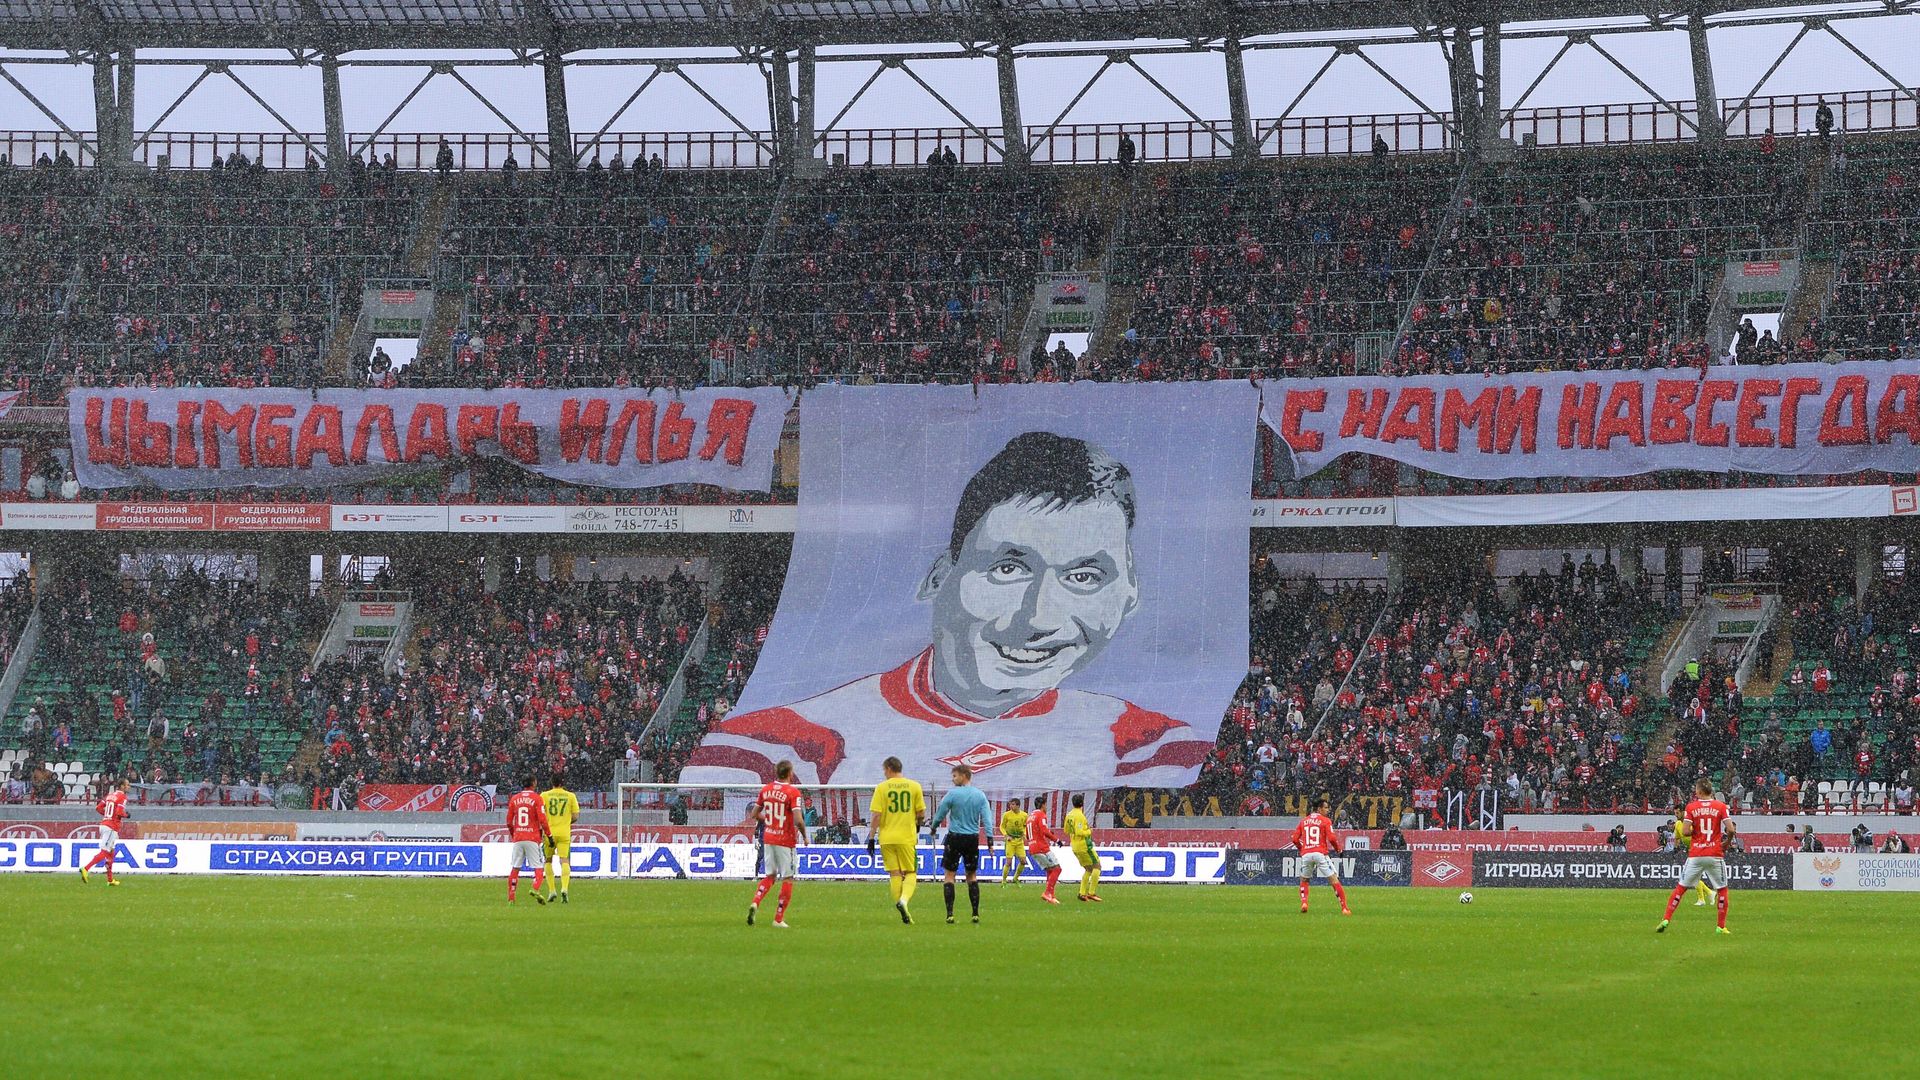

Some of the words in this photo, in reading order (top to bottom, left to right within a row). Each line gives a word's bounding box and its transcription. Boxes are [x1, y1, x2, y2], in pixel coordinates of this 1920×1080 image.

[1281, 388, 1328, 452] С
[1339, 385, 1542, 454] НАМИ
[1557, 374, 1920, 450] НАВСЕГДА
[85, 396, 540, 468] ЦЫМБАЛАРЬ
[558, 398, 756, 467] ИЛЬЯ
[122, 506, 188, 514] ФЕДЕРАЛЬНАЯ
[240, 506, 306, 514] ФЕДЕРАЛЬНАЯ
[615, 507, 678, 517] РЕСТОРАН
[105, 516, 150, 524] ГРУЗОВАЯ
[152, 516, 203, 524] КОМПАНИЯ
[224, 516, 268, 524] ГРУЗОВАЯ
[271, 516, 321, 524] КОМПАНИЯ
[614, 519, 678, 531] 748-77-45
[548, 797, 568, 816] 87
[887, 790, 911, 813] 30
[518, 806, 529, 827] 6
[1303, 826, 1321, 845] 19
[1700, 817, 1714, 842] 4
[225, 849, 364, 865] СТРАХОВАЯ
[373, 851, 468, 866] ГРУППА
[1485, 863, 1565, 878] ИГРОВАЯ
[1570, 863, 1636, 879] ФОРМА
[1858, 878, 1887, 888] СОЮЗ
